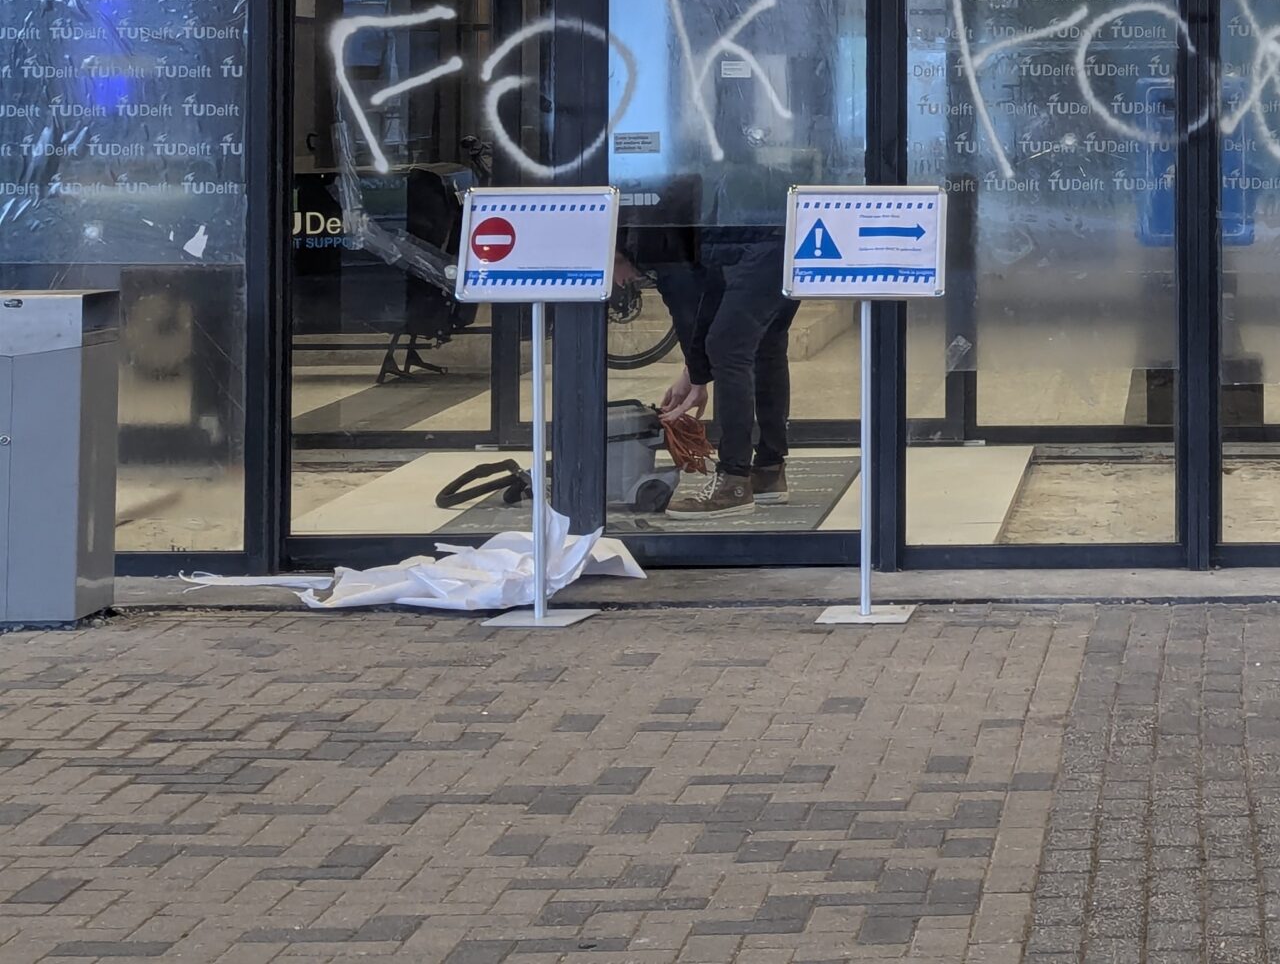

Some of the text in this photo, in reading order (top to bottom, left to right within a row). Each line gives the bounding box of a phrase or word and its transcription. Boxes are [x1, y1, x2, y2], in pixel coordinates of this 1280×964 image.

[183, 27, 240, 40] TUDelft
[1111, 26, 1167, 39] TUDelft
[155, 66, 212, 78] TUDelft
[1020, 63, 1075, 77] TUDelft
[49, 104, 106, 117] TUDelft
[116, 104, 173, 117] TUDelft
[182, 104, 240, 117] TUDelft
[1111, 101, 1166, 115] TUDelft
[87, 143, 145, 156] TUDelft
[154, 143, 211, 156] TUDelft
[1084, 140, 1139, 153] TUDelft
[181, 182, 238, 195] TUDelft
[945, 178, 975, 192] Delft
[984, 178, 1039, 192] TUDelft
[1048, 178, 1104, 192] TUDelft
[305, 236, 354, 249] SUPPO
